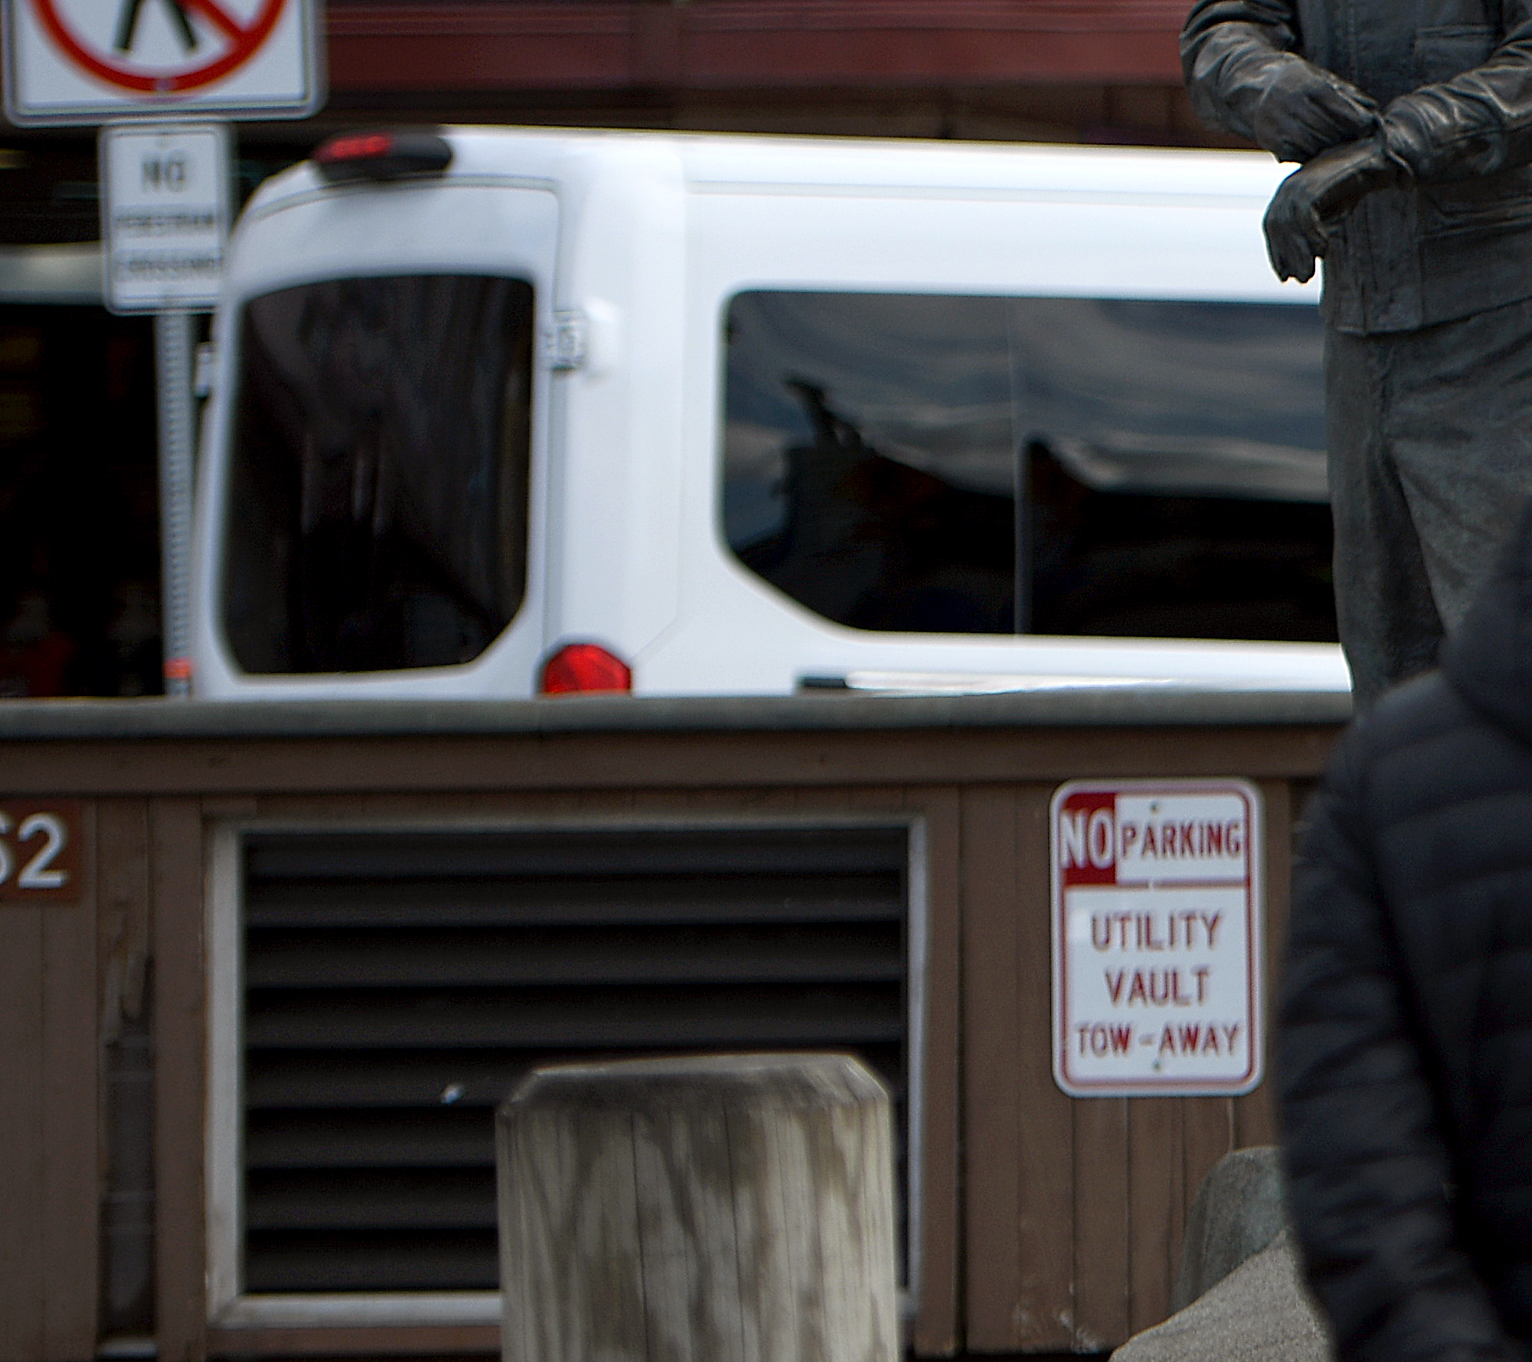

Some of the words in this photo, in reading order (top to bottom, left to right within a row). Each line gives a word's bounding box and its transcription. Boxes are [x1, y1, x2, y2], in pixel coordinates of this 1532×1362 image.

[141, 153, 187, 192] NO
[0, 810, 67, 889] 2
[1059, 807, 1116, 870] NO
[1120, 819, 1243, 861] PARKING
[1090, 908, 1222, 952] UTILITY
[1105, 964, 1212, 1008] VAULT
